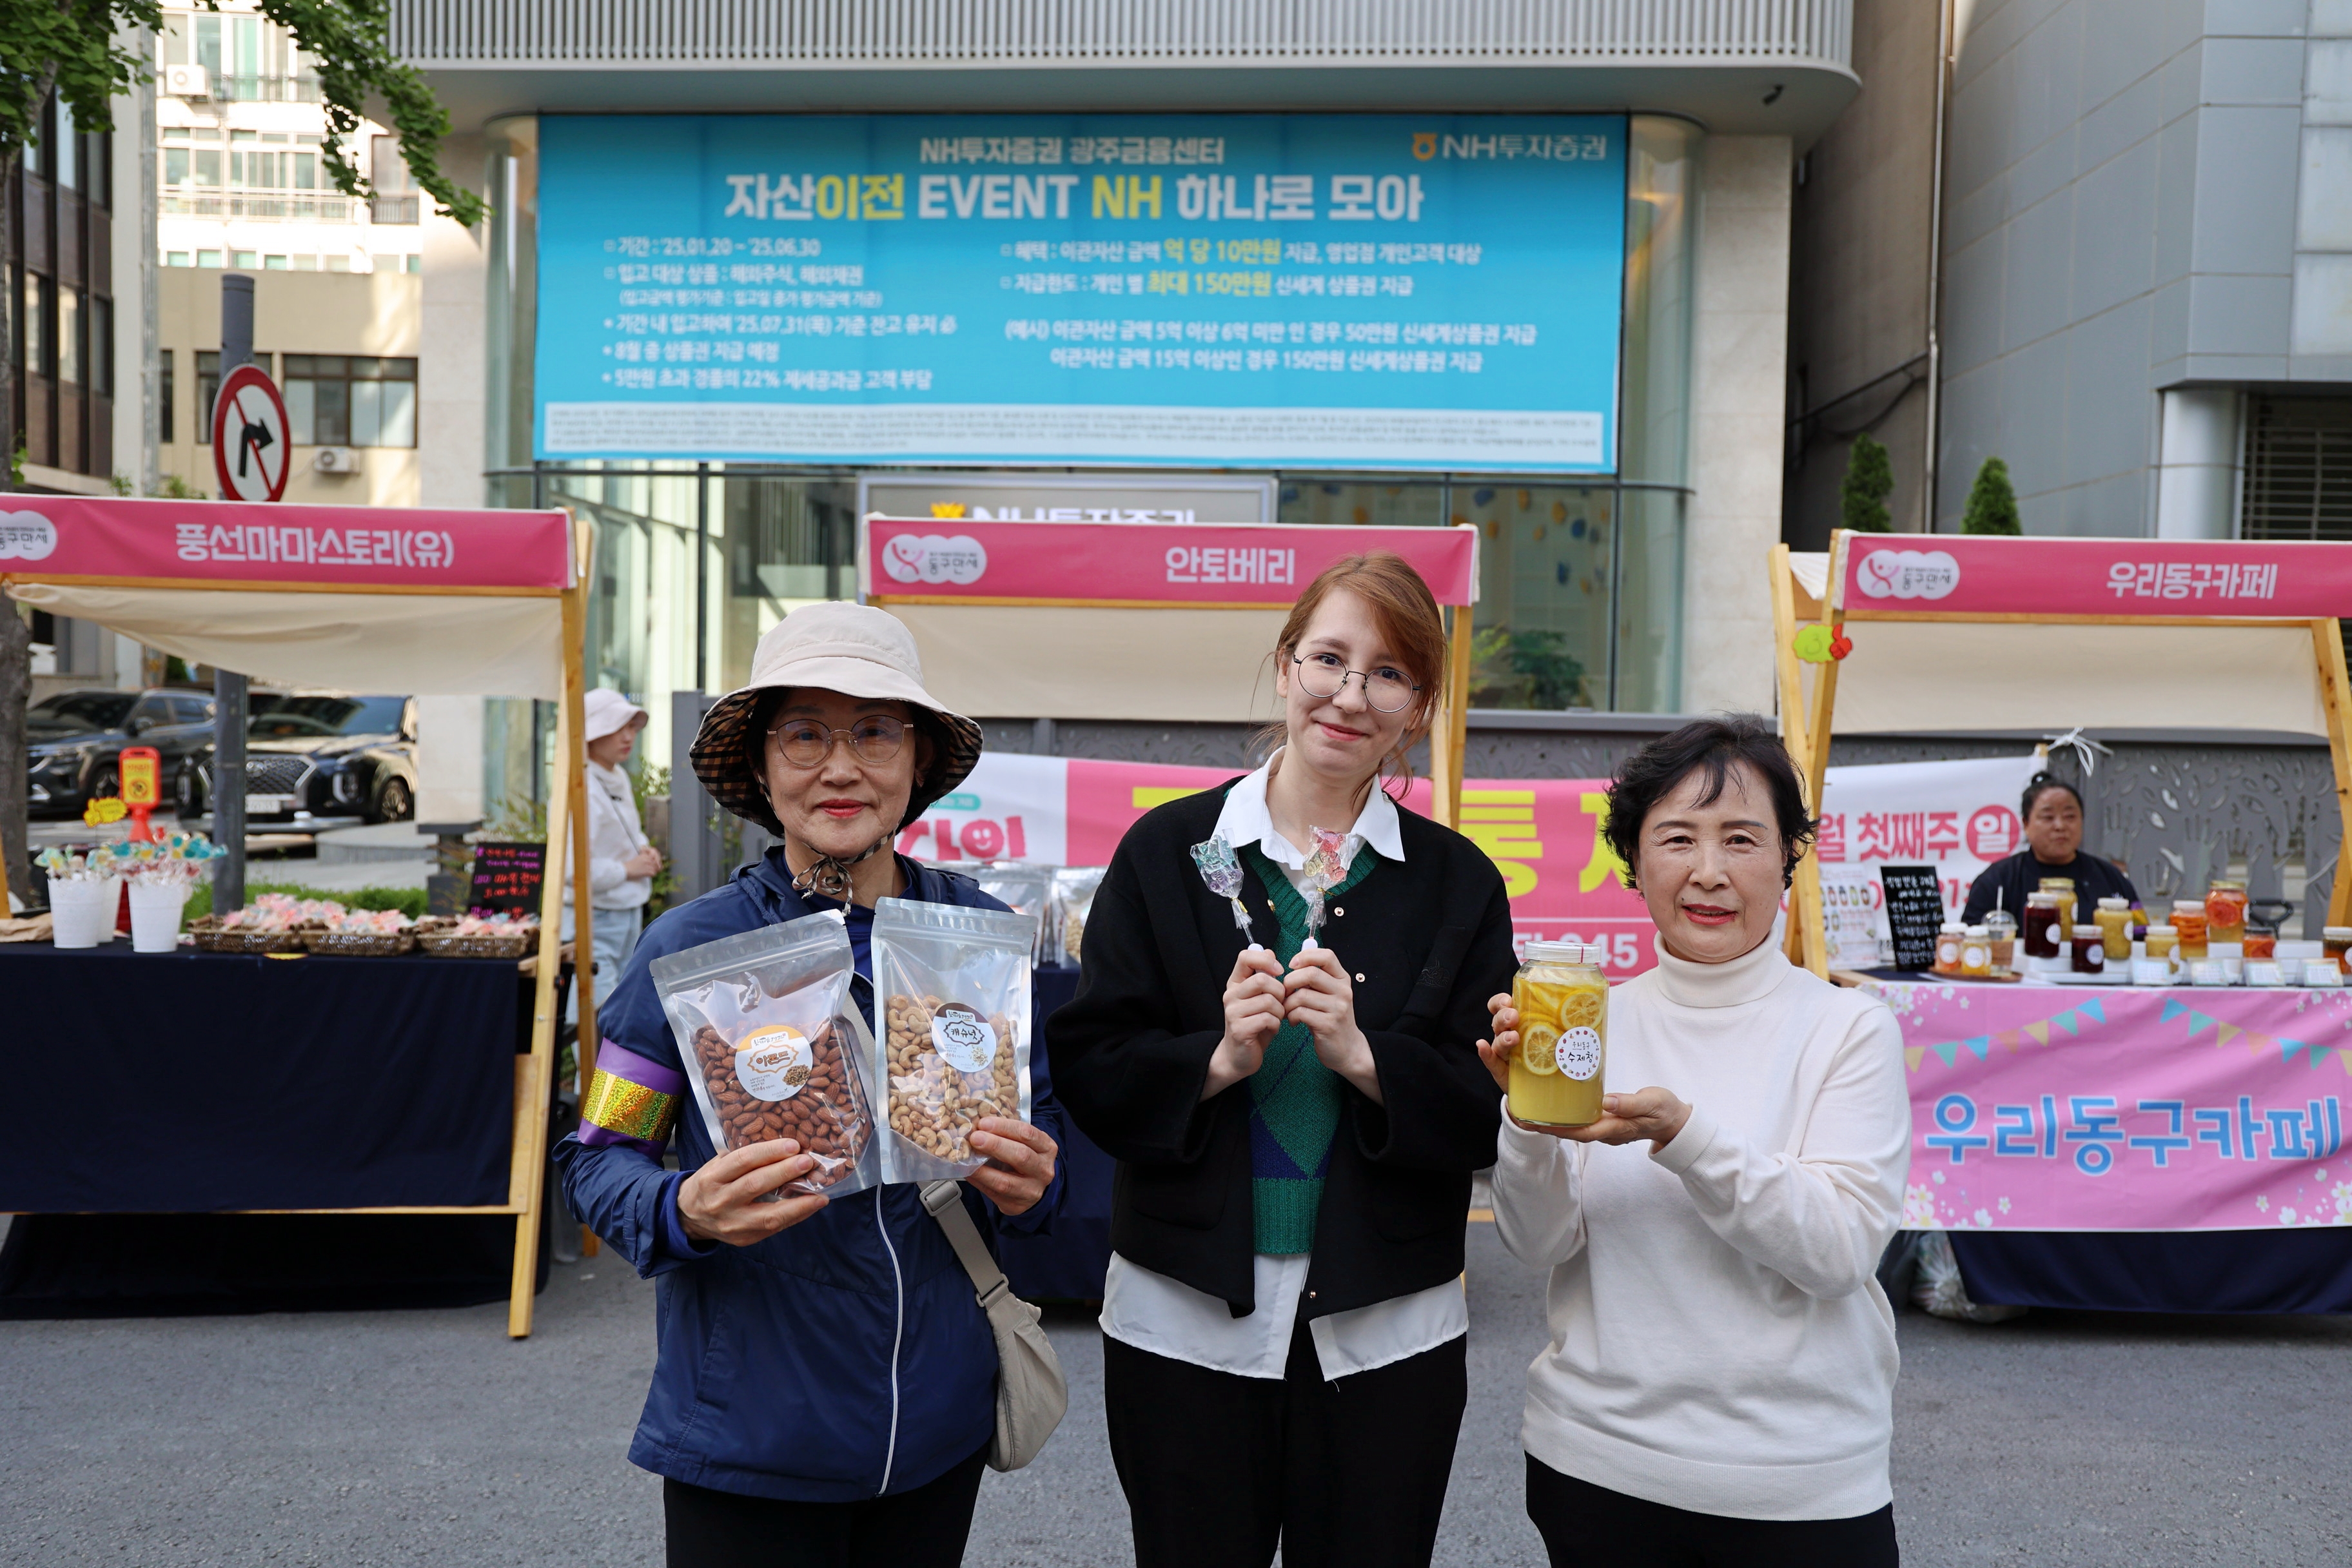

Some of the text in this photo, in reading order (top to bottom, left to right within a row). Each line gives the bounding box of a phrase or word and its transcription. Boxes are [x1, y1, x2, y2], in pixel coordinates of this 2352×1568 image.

[920, 137, 1224, 165] NH투자증권 광주금융센터
[1443, 135, 1607, 161] NH투자증권
[725, 174, 1425, 222] 자산이전 EVENT NH 하나로 모아
[618, 236, 649, 257] 기간
[1014, 240, 1048, 262] 혜택
[1059, 240, 1125, 262] 이관자산
[1128, 240, 1161, 262] 금액
[1163, 239, 1184, 263] 억
[1190, 238, 1211, 264] 당
[1217, 238, 1281, 264] 10만원
[1447, 242, 1482, 265] 대상
[618, 263, 651, 284] 입고
[652, 263, 685, 284] 대상
[687, 263, 719, 284] 상품
[1146, 270, 1189, 296] 최대
[1195, 271, 1271, 297] 150만원
[1275, 275, 1325, 296] 신세계
[1328, 275, 1377, 297] 상품권
[1379, 275, 1414, 297] 지급
[616, 313, 648, 335] 기간
[650, 313, 669, 335] 내
[670, 313, 732, 335] 입고하여
[834, 315, 867, 336] 기준
[870, 314, 903, 336] 잔고
[905, 313, 937, 335] 유지
[1052, 319, 1117, 342] 이관자산
[1120, 320, 1153, 342] 금액
[1155, 320, 1183, 343] 5억
[1185, 321, 1219, 343] 이상
[1221, 321, 1250, 343] 6억
[1251, 321, 1285, 344] 미만
[1309, 322, 1342, 344] 경우
[1345, 322, 1399, 344] 50만원
[1502, 324, 1537, 346] 지급
[614, 340, 643, 362] 8월
[664, 340, 711, 362] 상품권
[713, 340, 745, 362] 지급
[747, 340, 780, 363] 예정
[1049, 347, 1115, 369] 이관자산
[1117, 347, 1152, 369] 금액
[1154, 348, 1190, 370] 15억
[1246, 349, 1279, 371] 경우
[1282, 349, 1346, 371] 150만원
[1449, 351, 1483, 373] 지급
[614, 368, 656, 389] 5만원
[658, 368, 691, 389] 초과
[742, 369, 781, 389] 22%
[783, 369, 861, 391] 제세공과금
[864, 369, 897, 391] 고객
[899, 369, 933, 391] 부담
[175, 523, 455, 568] 풍선마마스토리(유)
[1165, 547, 1295, 586] 안토베리
[2106, 561, 2278, 600] 우리동구카페
[1857, 811, 1959, 861] 첫째주
[1974, 812, 2011, 854] 일
[951, 1028, 977, 1041] 캐슈넛
[1573, 1041, 1590, 1050] 우리동구
[756, 1050, 790, 1067] 아몬드
[1568, 1051, 1593, 1063] 수제청
[1925, 1093, 2342, 1177] 우리동구카페
